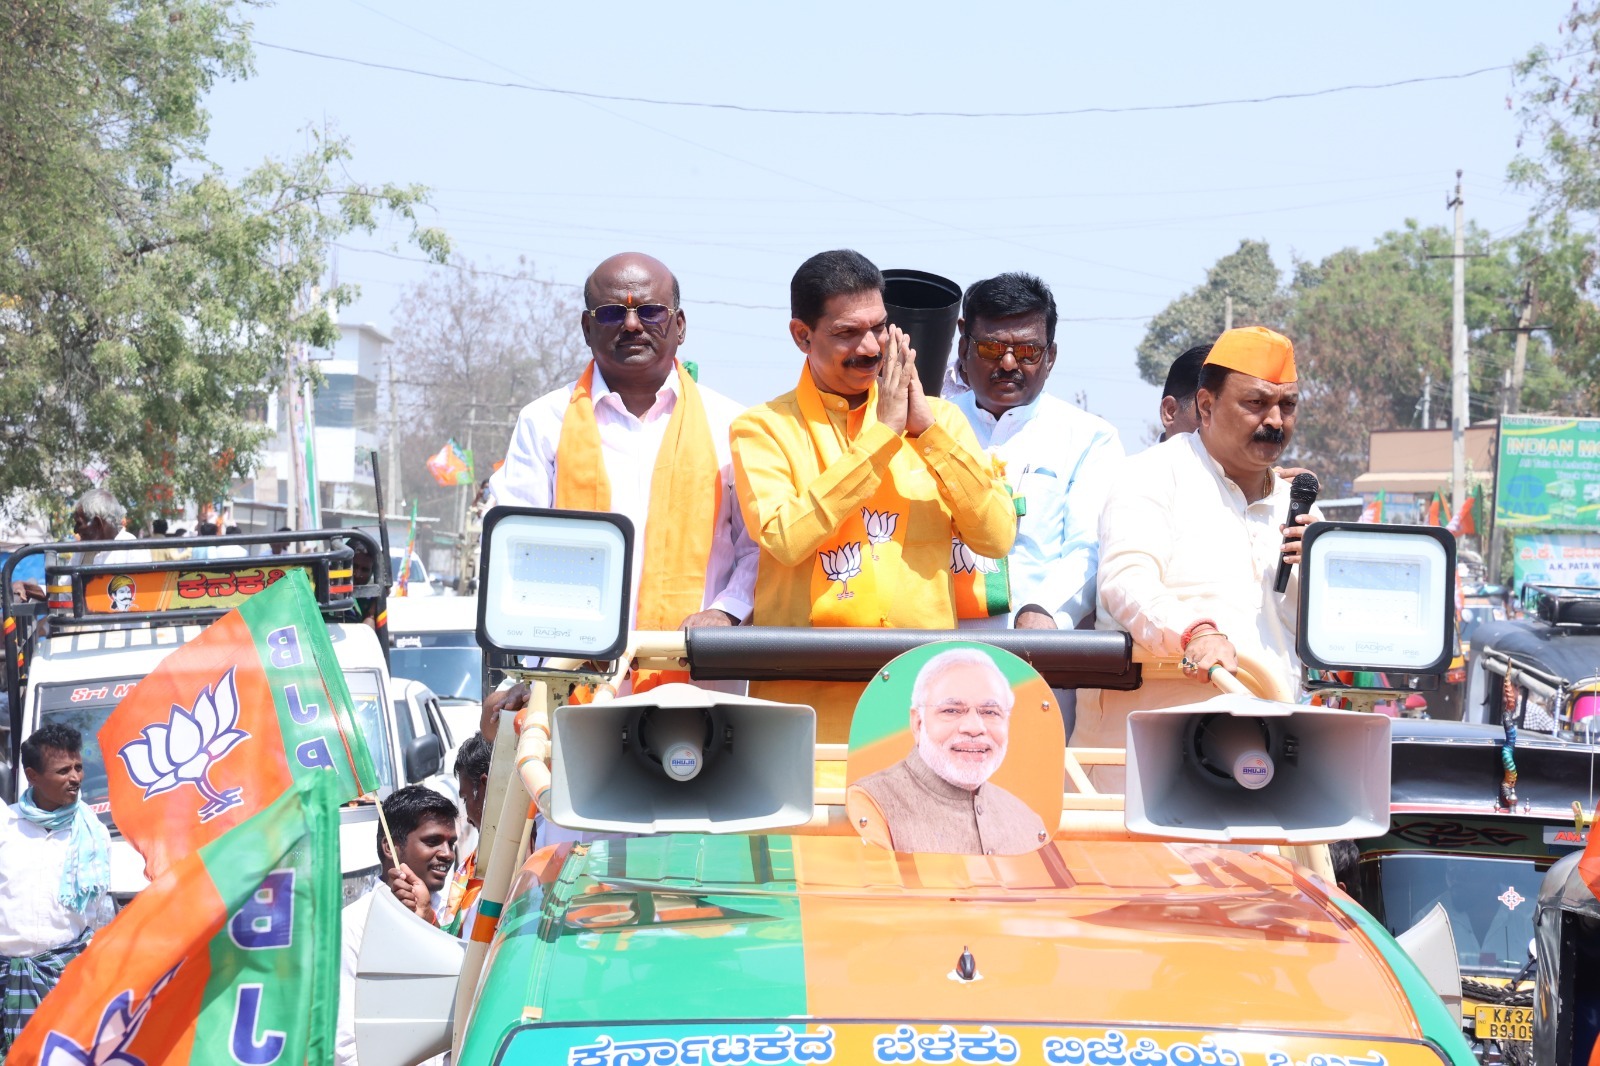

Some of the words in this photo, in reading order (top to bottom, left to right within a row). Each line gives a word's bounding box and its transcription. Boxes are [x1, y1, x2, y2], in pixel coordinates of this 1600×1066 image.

[1507, 438, 1574, 457] INDIAN
[1569, 562, 1590, 570] PATA
[70, 687, 109, 702] Sri
[1242, 766, 1267, 776] AHUJA
[873, 1025, 1020, 1065] ಬೆಳಕು
